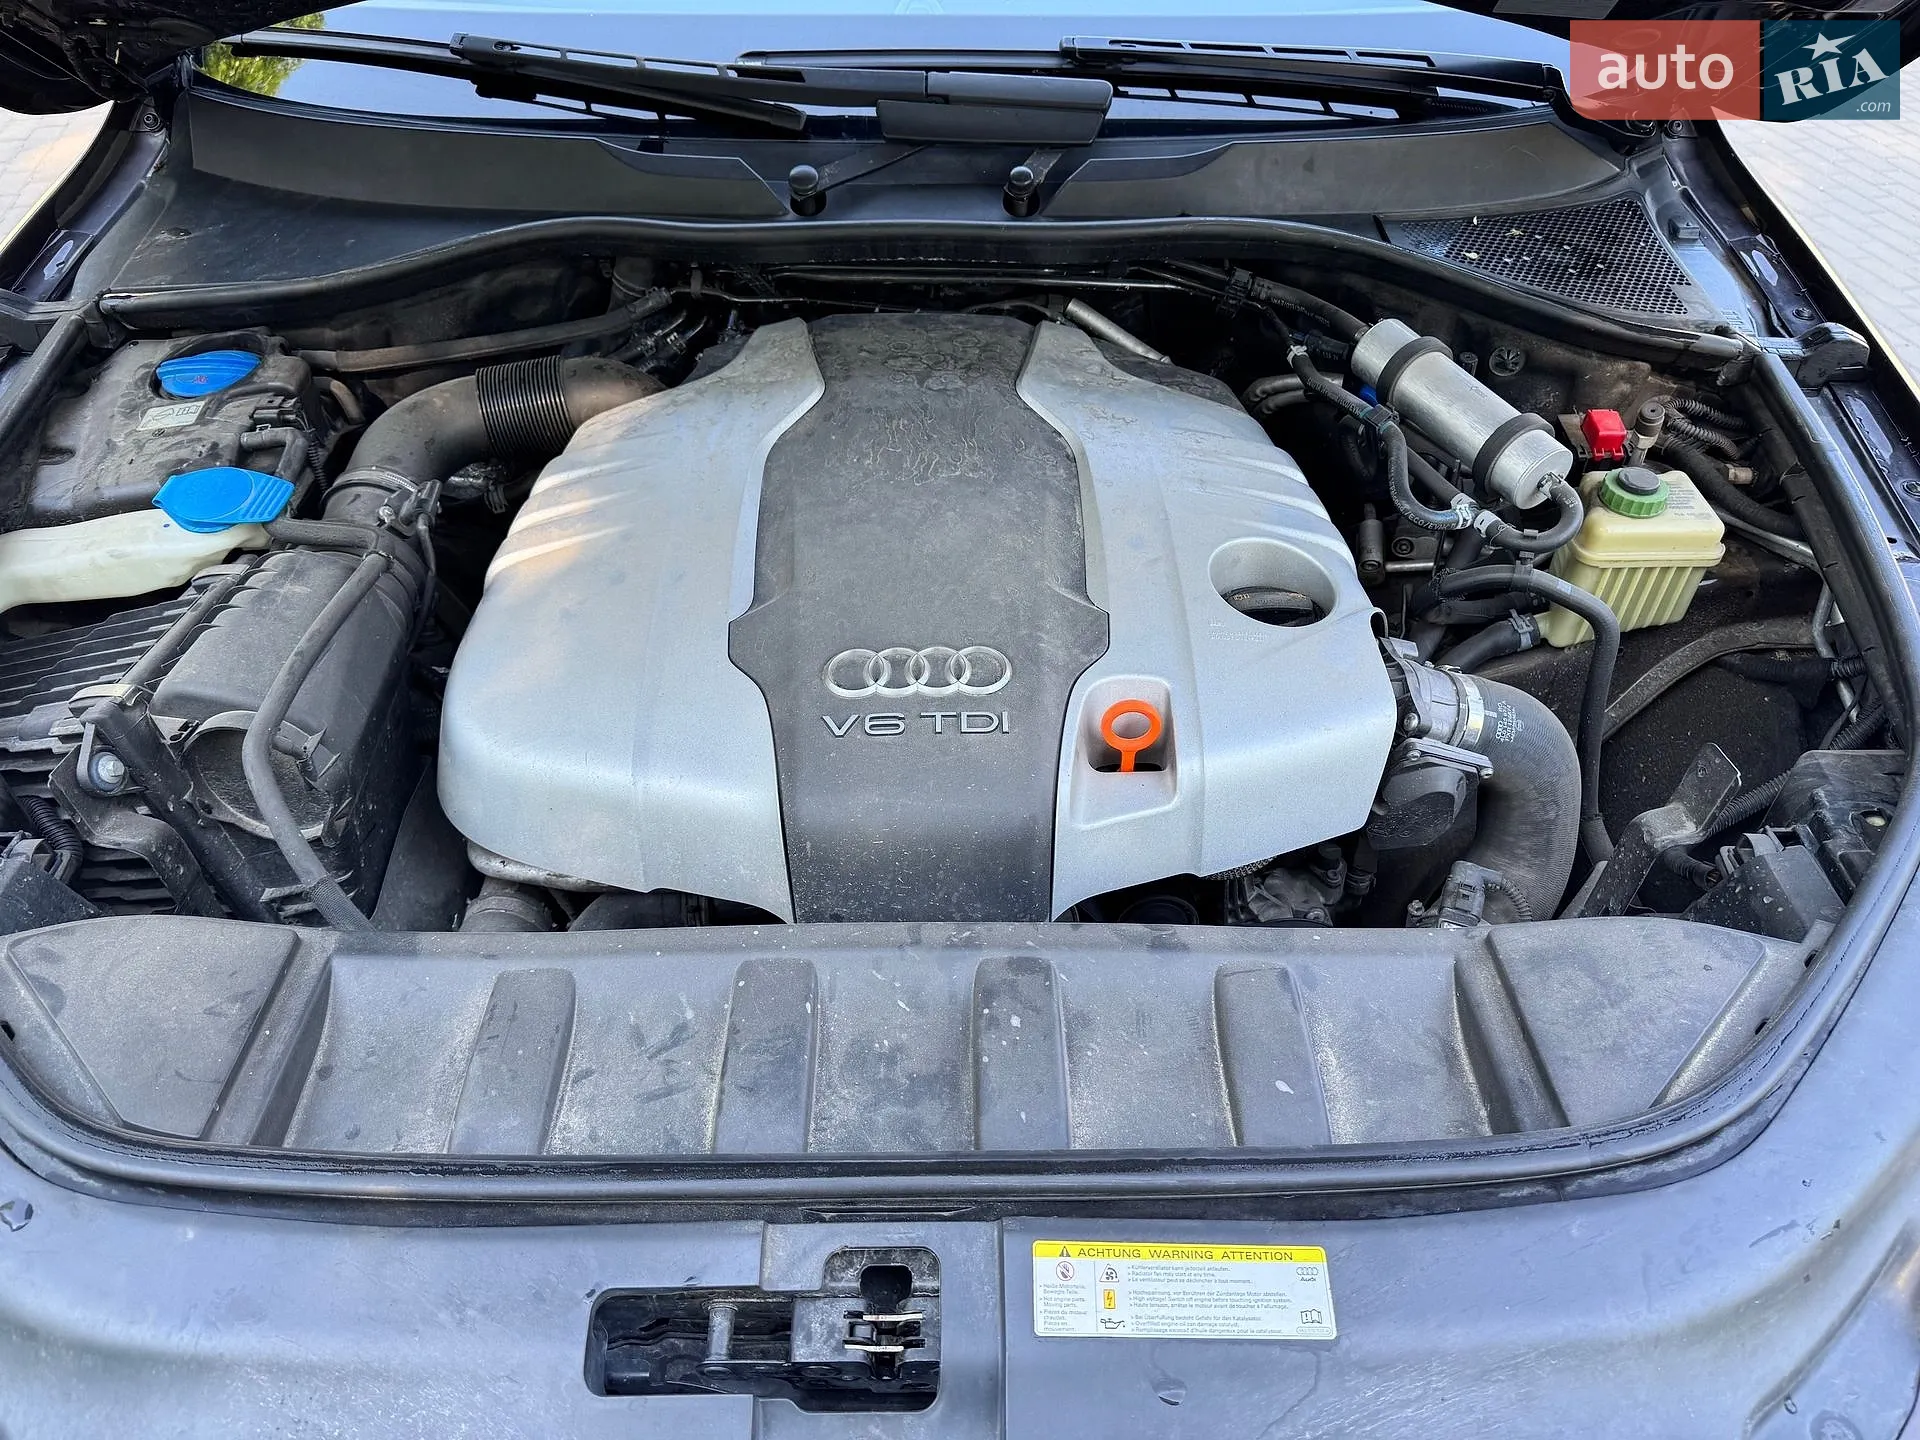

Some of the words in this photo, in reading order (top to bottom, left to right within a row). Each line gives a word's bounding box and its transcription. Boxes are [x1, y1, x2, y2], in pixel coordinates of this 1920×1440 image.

[821, 712, 905, 737] V6
[920, 711, 1009, 735] TDI
[1077, 1248, 1141, 1258] ACHTUNG
[1149, 1249, 1214, 1260] WARNING
[1221, 1251, 1293, 1260] ATTENTION
